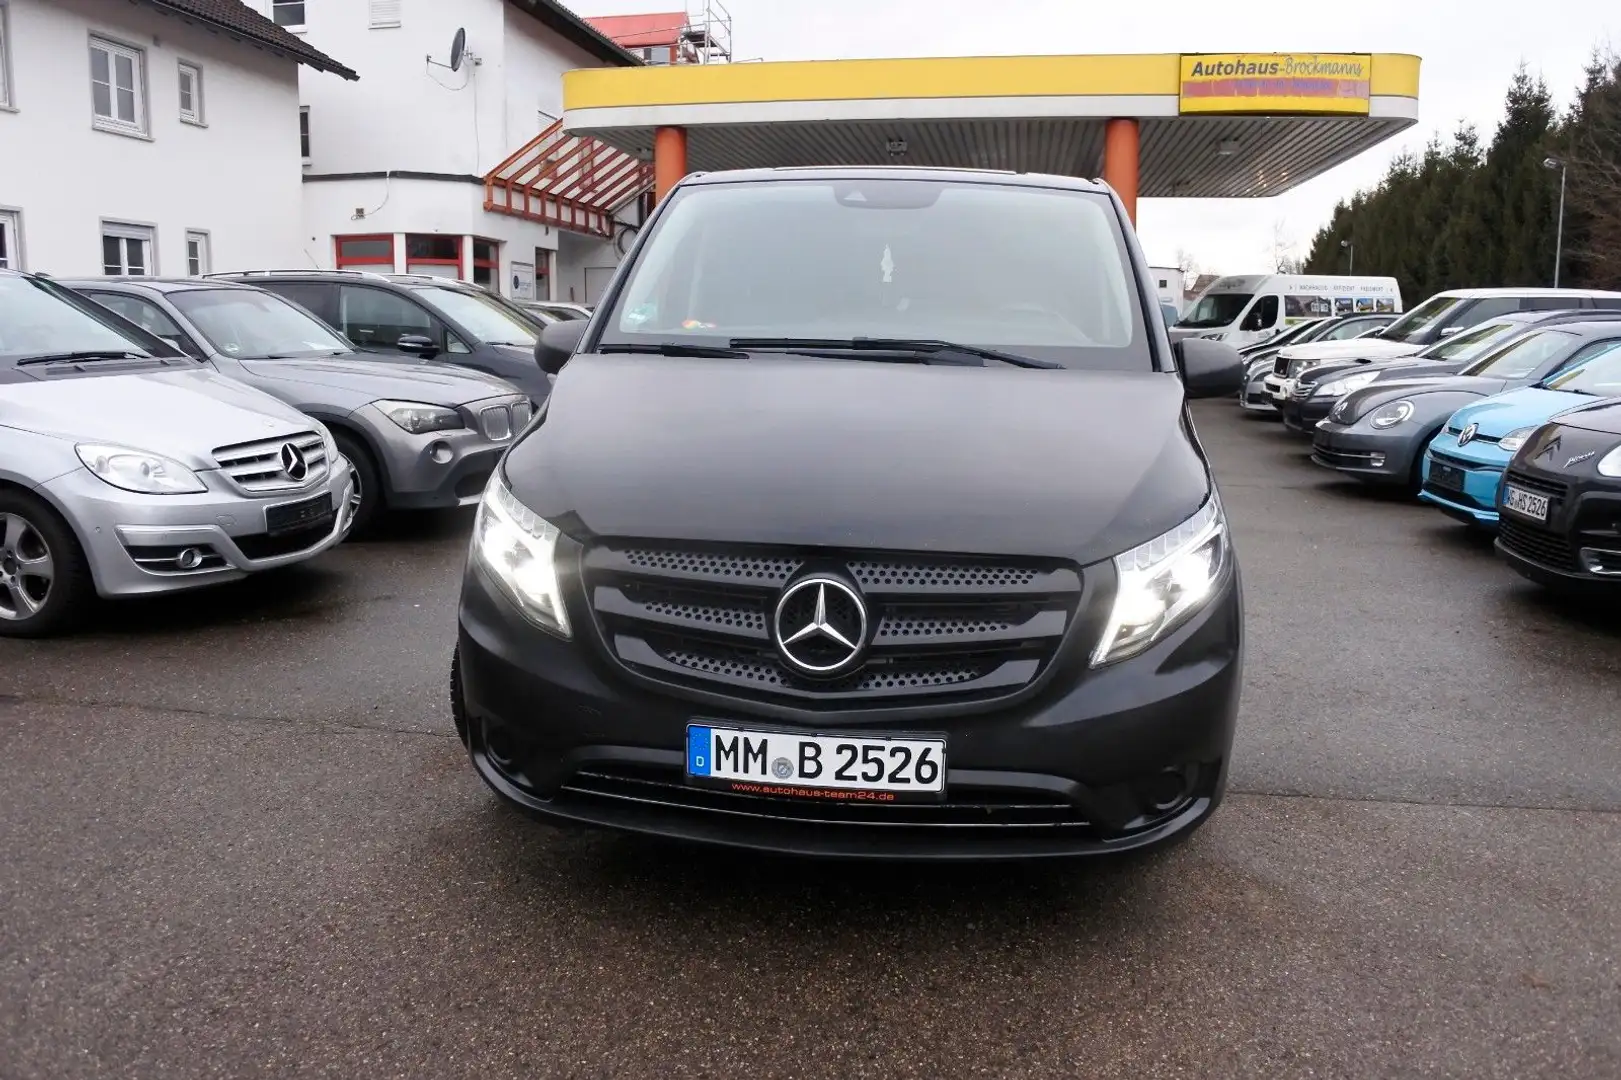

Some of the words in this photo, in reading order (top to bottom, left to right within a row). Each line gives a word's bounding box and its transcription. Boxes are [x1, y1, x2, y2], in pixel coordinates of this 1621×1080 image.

[1527, 496, 1547, 517] 2526
[695, 756, 705, 767] D
[715, 734, 768, 776] MM
[798, 741, 823, 779] B
[834, 743, 939, 785] 2526
[731, 782, 895, 801] www.autohaus-team24.de
